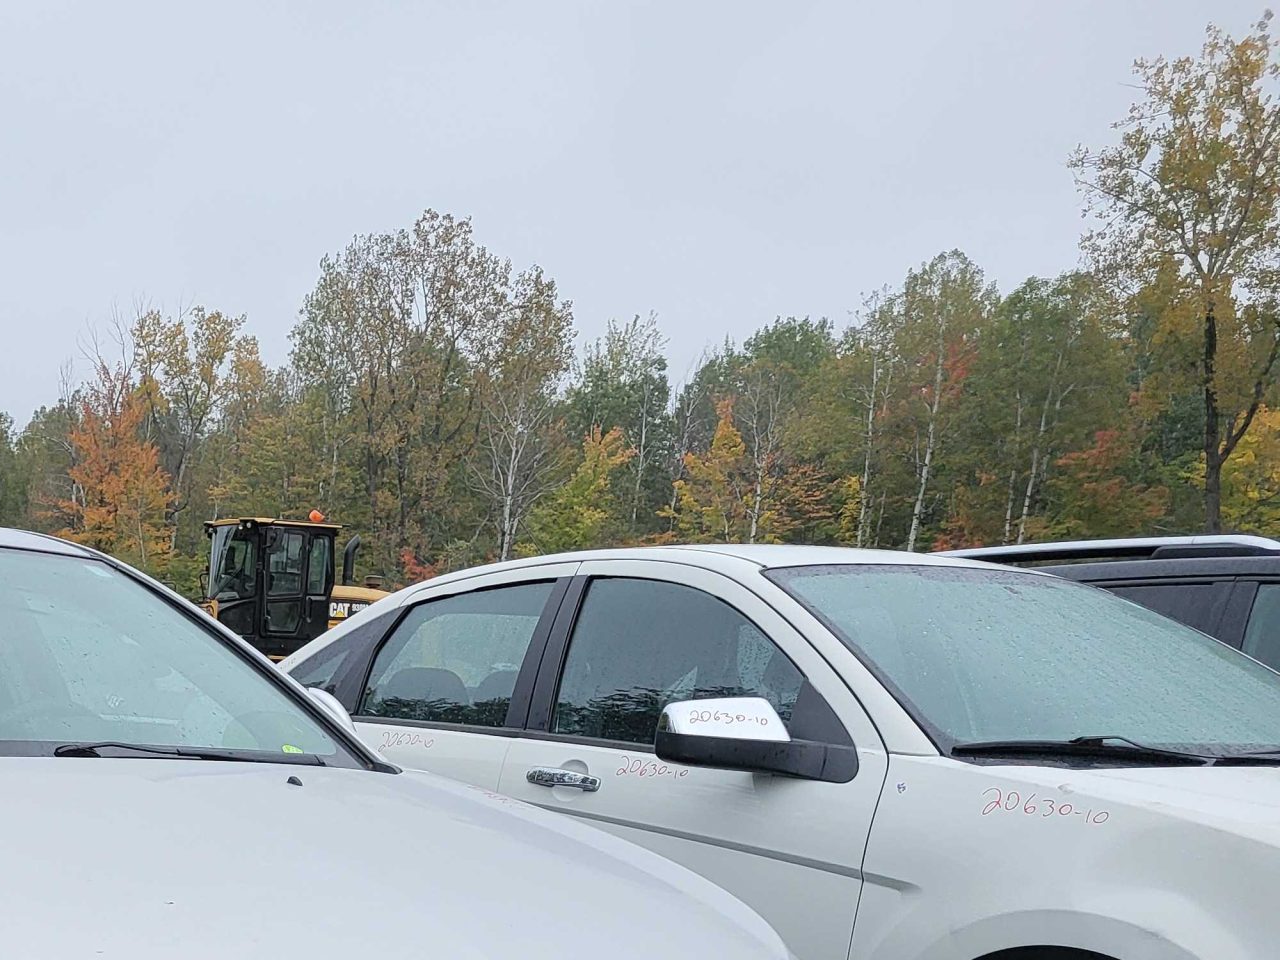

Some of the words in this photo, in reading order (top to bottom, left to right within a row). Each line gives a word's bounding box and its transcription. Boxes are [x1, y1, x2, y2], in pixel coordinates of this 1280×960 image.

[330, 602, 350, 618] CAT
[689, 709, 768, 726] 20630-10
[616, 755, 689, 779] 20630-10
[981, 787, 1109, 824] 20630-10
